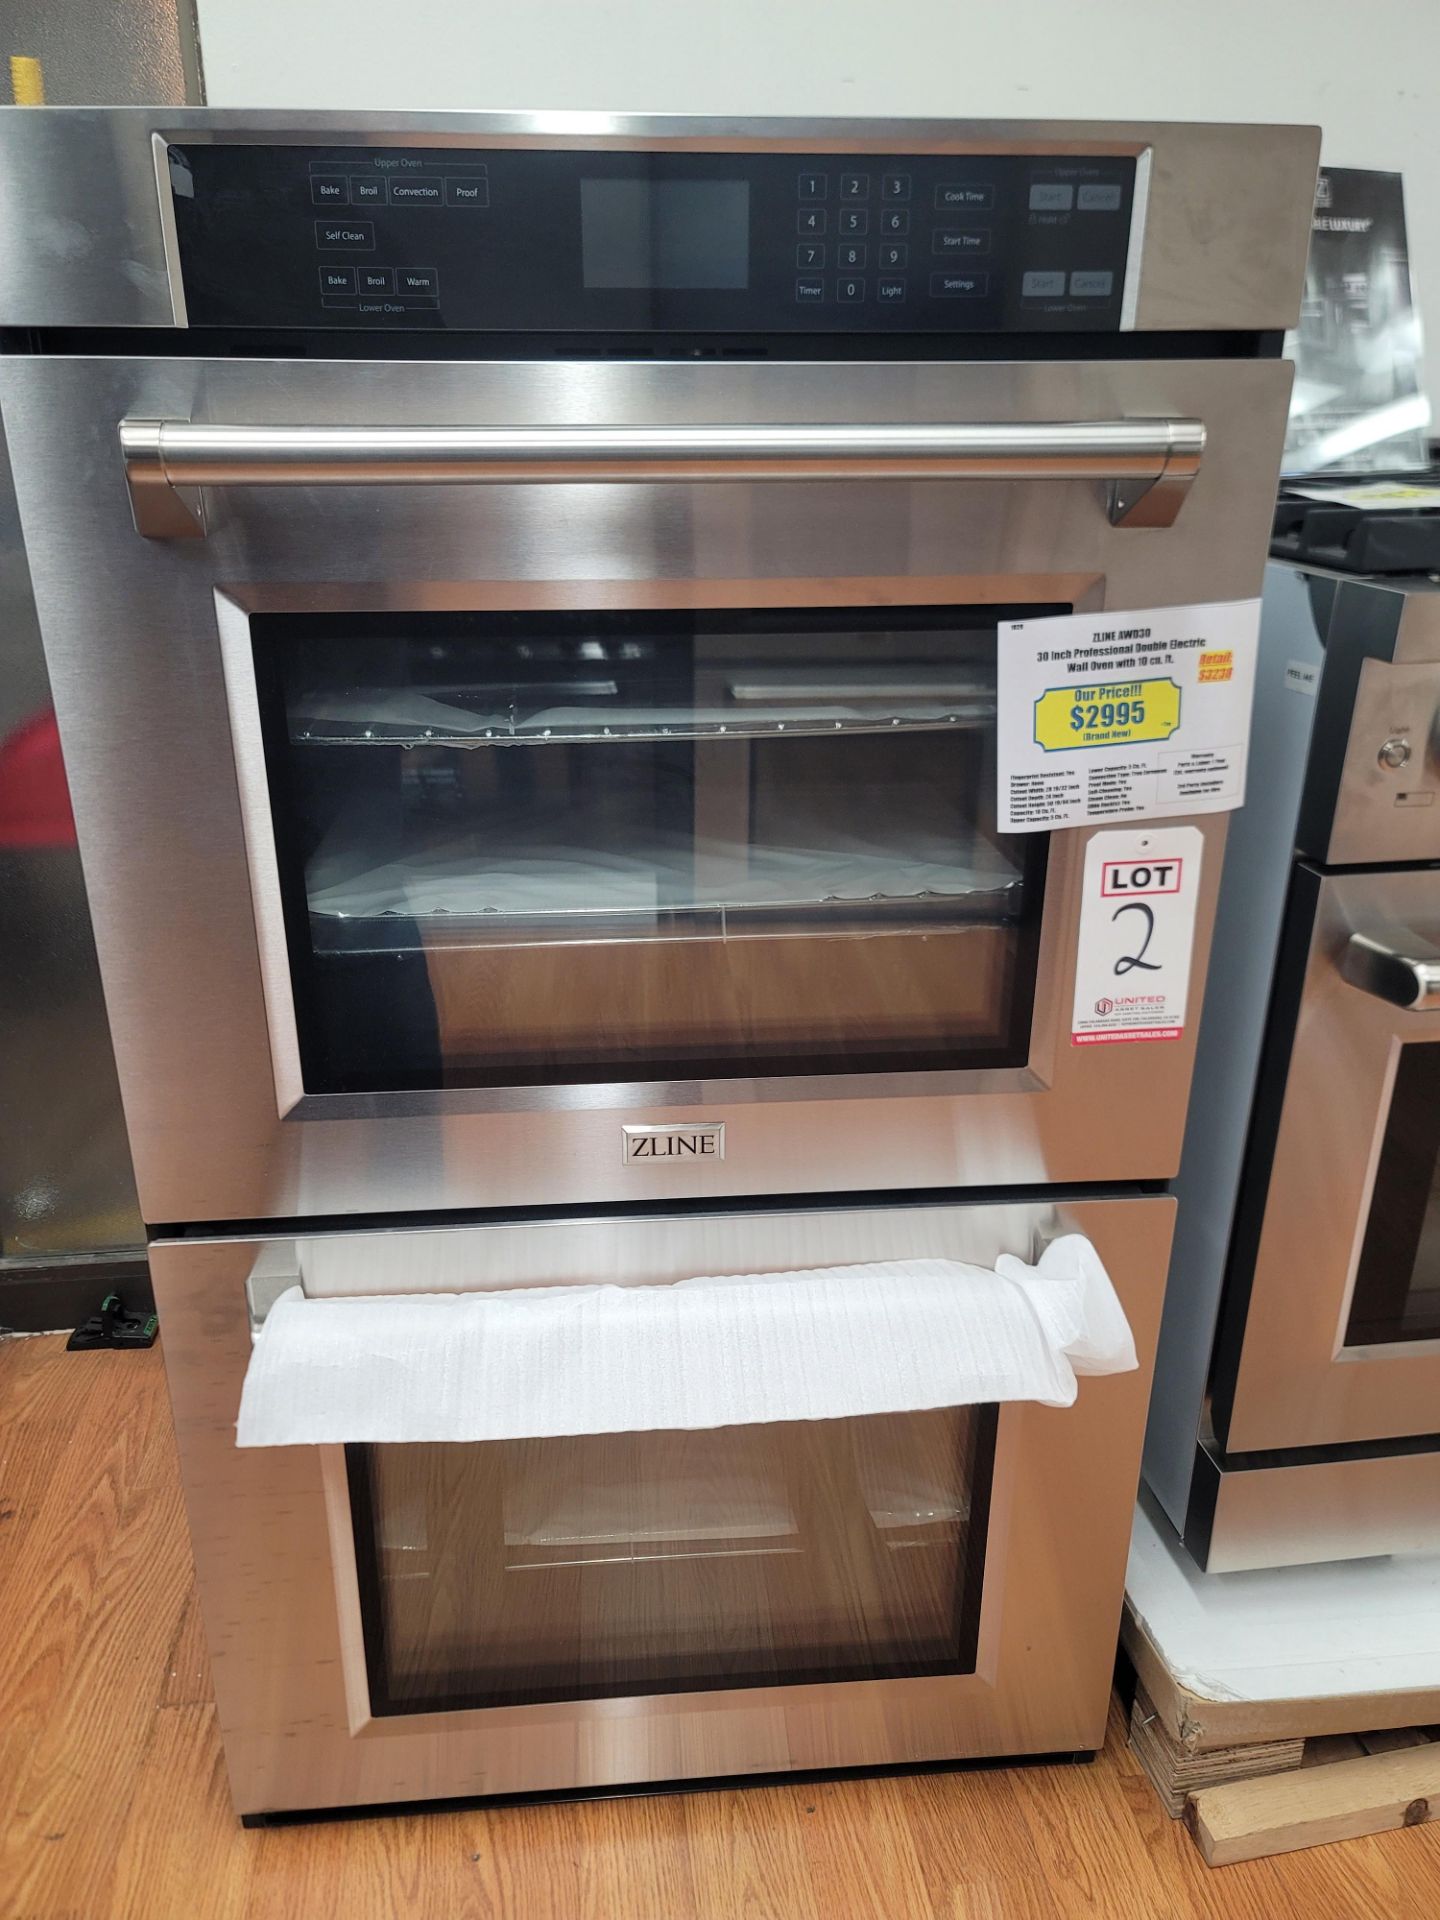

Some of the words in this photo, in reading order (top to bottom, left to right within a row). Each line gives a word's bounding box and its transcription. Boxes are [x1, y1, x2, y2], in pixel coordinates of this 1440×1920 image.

[374, 159, 399, 168] Upper
[401, 159, 422, 167] Oven
[320, 186, 340, 195] Bake
[360, 186, 378, 195] Broil
[393, 187, 439, 197] Convection
[456, 188, 478, 197] Proof
[810, 181, 815, 193] 1
[851, 181, 859, 193] 2
[893, 181, 900, 194] 3
[945, 192, 962, 202] Cook
[964, 192, 984, 202] Time
[808, 216, 816, 228] 4
[850, 216, 857, 228] 5
[892, 216, 900, 229] 6
[325, 231, 341, 240] Self
[342, 231, 364, 241] Clean
[943, 236, 961, 247] Start
[962, 236, 981, 247] Time
[807, 251, 815, 263] 7
[849, 251, 856, 263] 8
[890, 251, 898, 263] 9
[328, 277, 347, 285] Bake
[367, 277, 385, 286] Broil
[407, 278, 430, 286] Warm
[943, 279, 975, 291] Settings
[799, 286, 822, 296] Timer
[847, 284, 855, 296] 0
[882, 286, 902, 298] Light
[359, 304, 382, 312] Lower
[384, 304, 405, 312] Oven
[1092, 631, 1116, 643] ZLINE
[1037, 652, 1050, 662] 30
[1051, 649, 1072, 661] Inch
[1074, 644, 1134, 659] Professional
[1135, 640, 1168, 654] Double
[1169, 638, 1206, 650] Electric
[1067, 662, 1089, 673] Wall
[1090, 661, 1114, 672] Oven
[1115, 659, 1136, 670] with
[1138, 657, 1148, 667] 10
[1074, 687, 1097, 702] Our
[1099, 684, 1142, 700] Price!!!
[1070, 701, 1145, 732] $2995
[1083, 731, 1111, 742] (Brand
[1112, 729, 1131, 740] New)
[1111, 866, 1173, 890] LOT
[1111, 902, 1162, 976] 2
[1115, 995, 1166, 1004] UNITED
[632, 1135, 715, 1157] ZLINE
